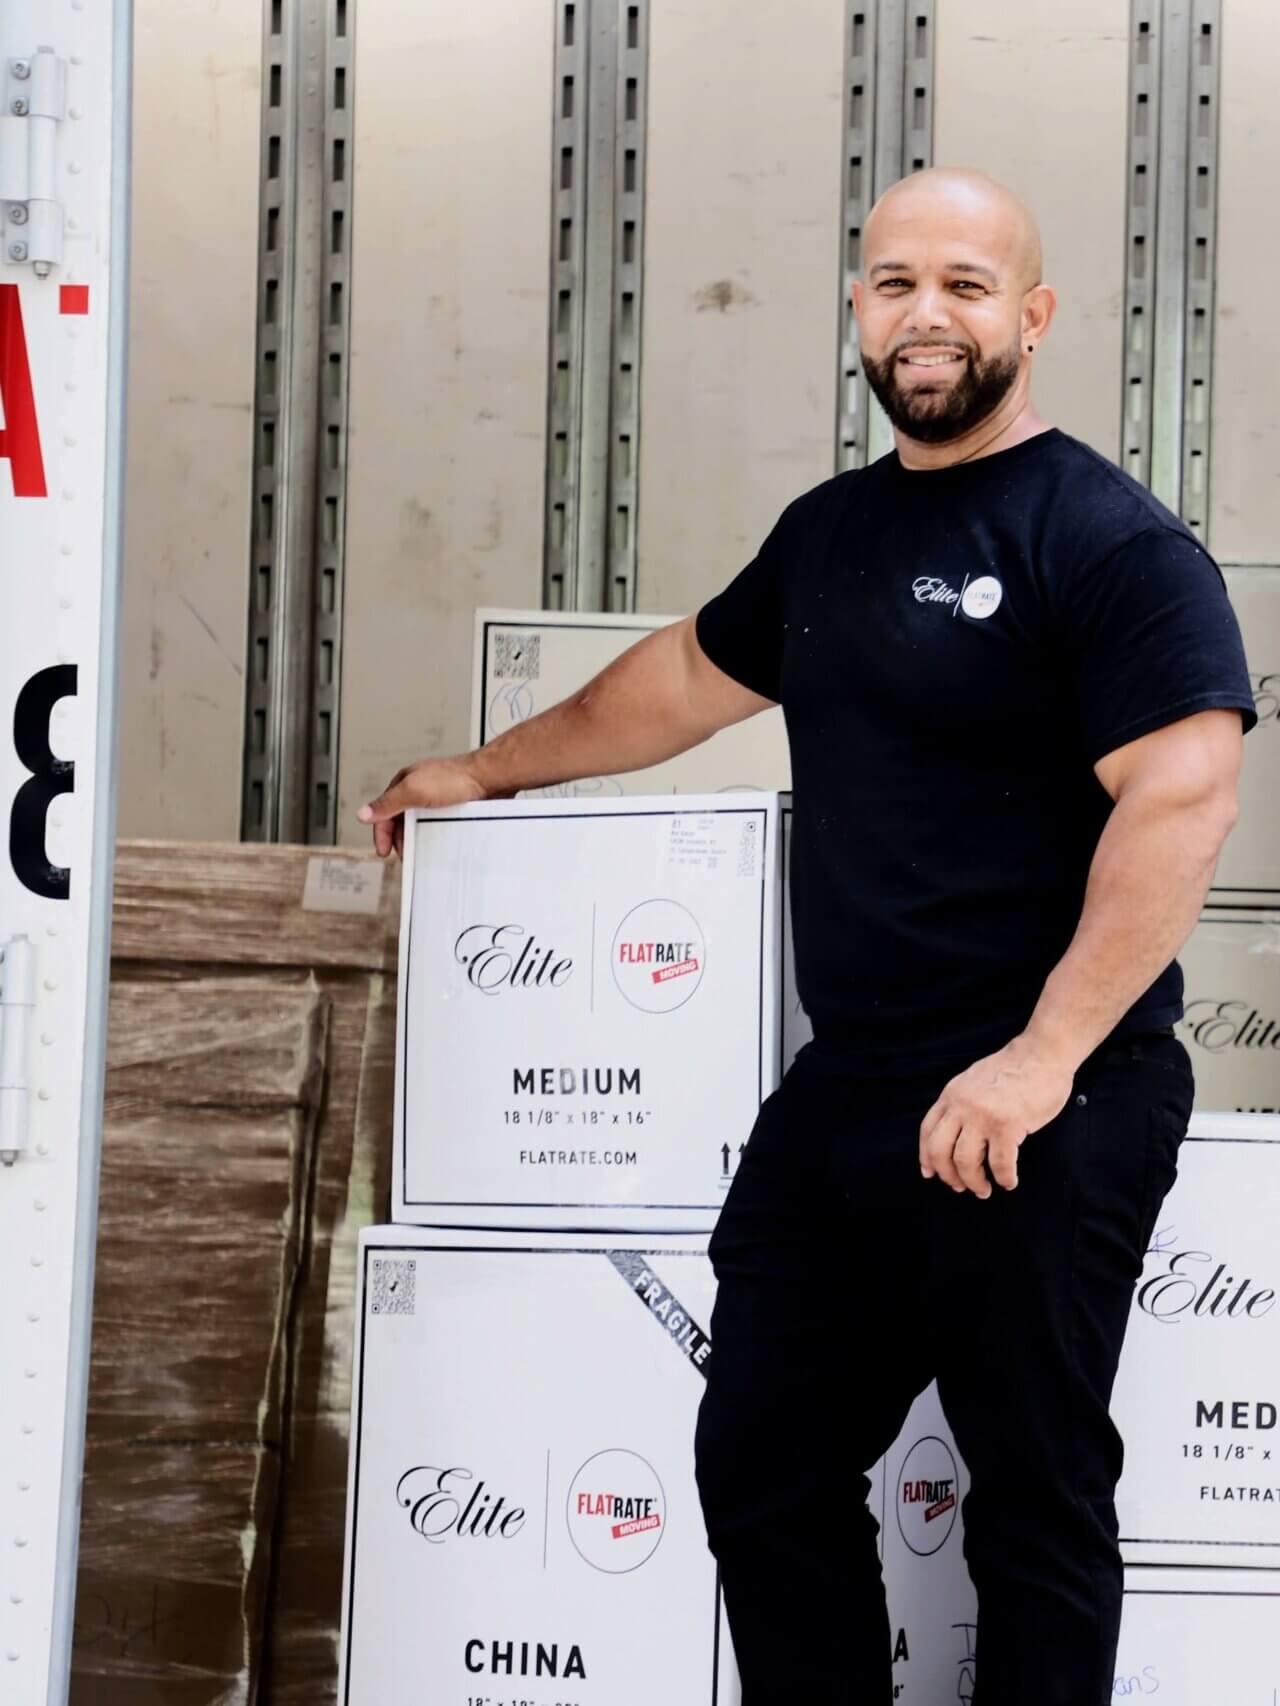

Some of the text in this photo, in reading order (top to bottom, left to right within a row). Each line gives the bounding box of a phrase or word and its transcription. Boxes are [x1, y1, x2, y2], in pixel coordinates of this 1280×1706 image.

[912, 576, 960, 603] Elite
[454, 924, 576, 996] Elite
[620, 942, 693, 963] FLATRATE
[659, 960, 697, 980] MOVING
[512, 1067, 642, 1096] MEDIUM
[504, 1110, 521, 1125] 18
[581, 1110, 606, 1125] 18"
[612, 1115, 619, 1124] x
[627, 1111, 651, 1125] 16"
[519, 1150, 637, 1166] FLATRATE.COM
[1138, 1250, 1277, 1324] Elite
[634, 1268, 712, 1365] FRAGILE
[1182, 1443, 1203, 1459] 18
[1213, 1444, 1254, 1462] 1/8"
[1263, 1451, 1271, 1461] x
[903, 1479, 953, 1503] FLATRATE
[396, 1465, 527, 1545] Elite
[577, 1493, 653, 1520] FLATRATE
[619, 1517, 658, 1536] MOVING
[464, 1638, 587, 1680] CHINA
